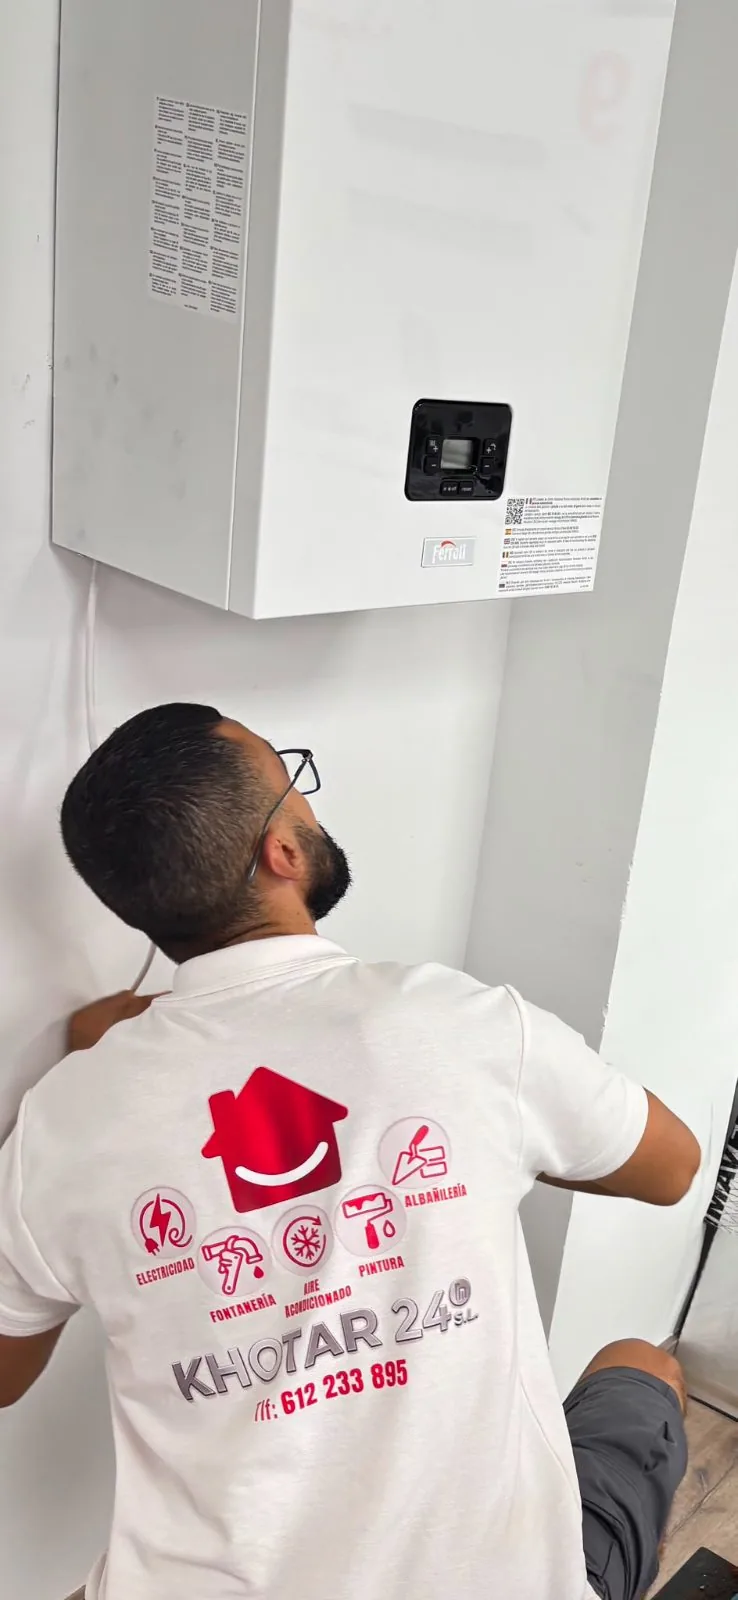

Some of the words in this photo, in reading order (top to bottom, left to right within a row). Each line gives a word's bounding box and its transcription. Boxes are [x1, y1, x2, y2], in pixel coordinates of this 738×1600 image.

[405, 1183, 467, 1208] ALBAÑILERÍA
[136, 1257, 195, 1285] ELECTRICIDAD
[358, 1256, 405, 1277] PINTURA
[303, 1279, 320, 1295] AIRE
[209, 1293, 277, 1323] FONTANERÍA
[171, 1307, 383, 1401] KHOTAR
[454, 1308, 478, 1327] S.L.
[280, 1382, 318, 1414] 612
[322, 1368, 364, 1399] 233
[370, 1359, 408, 1389] 895
